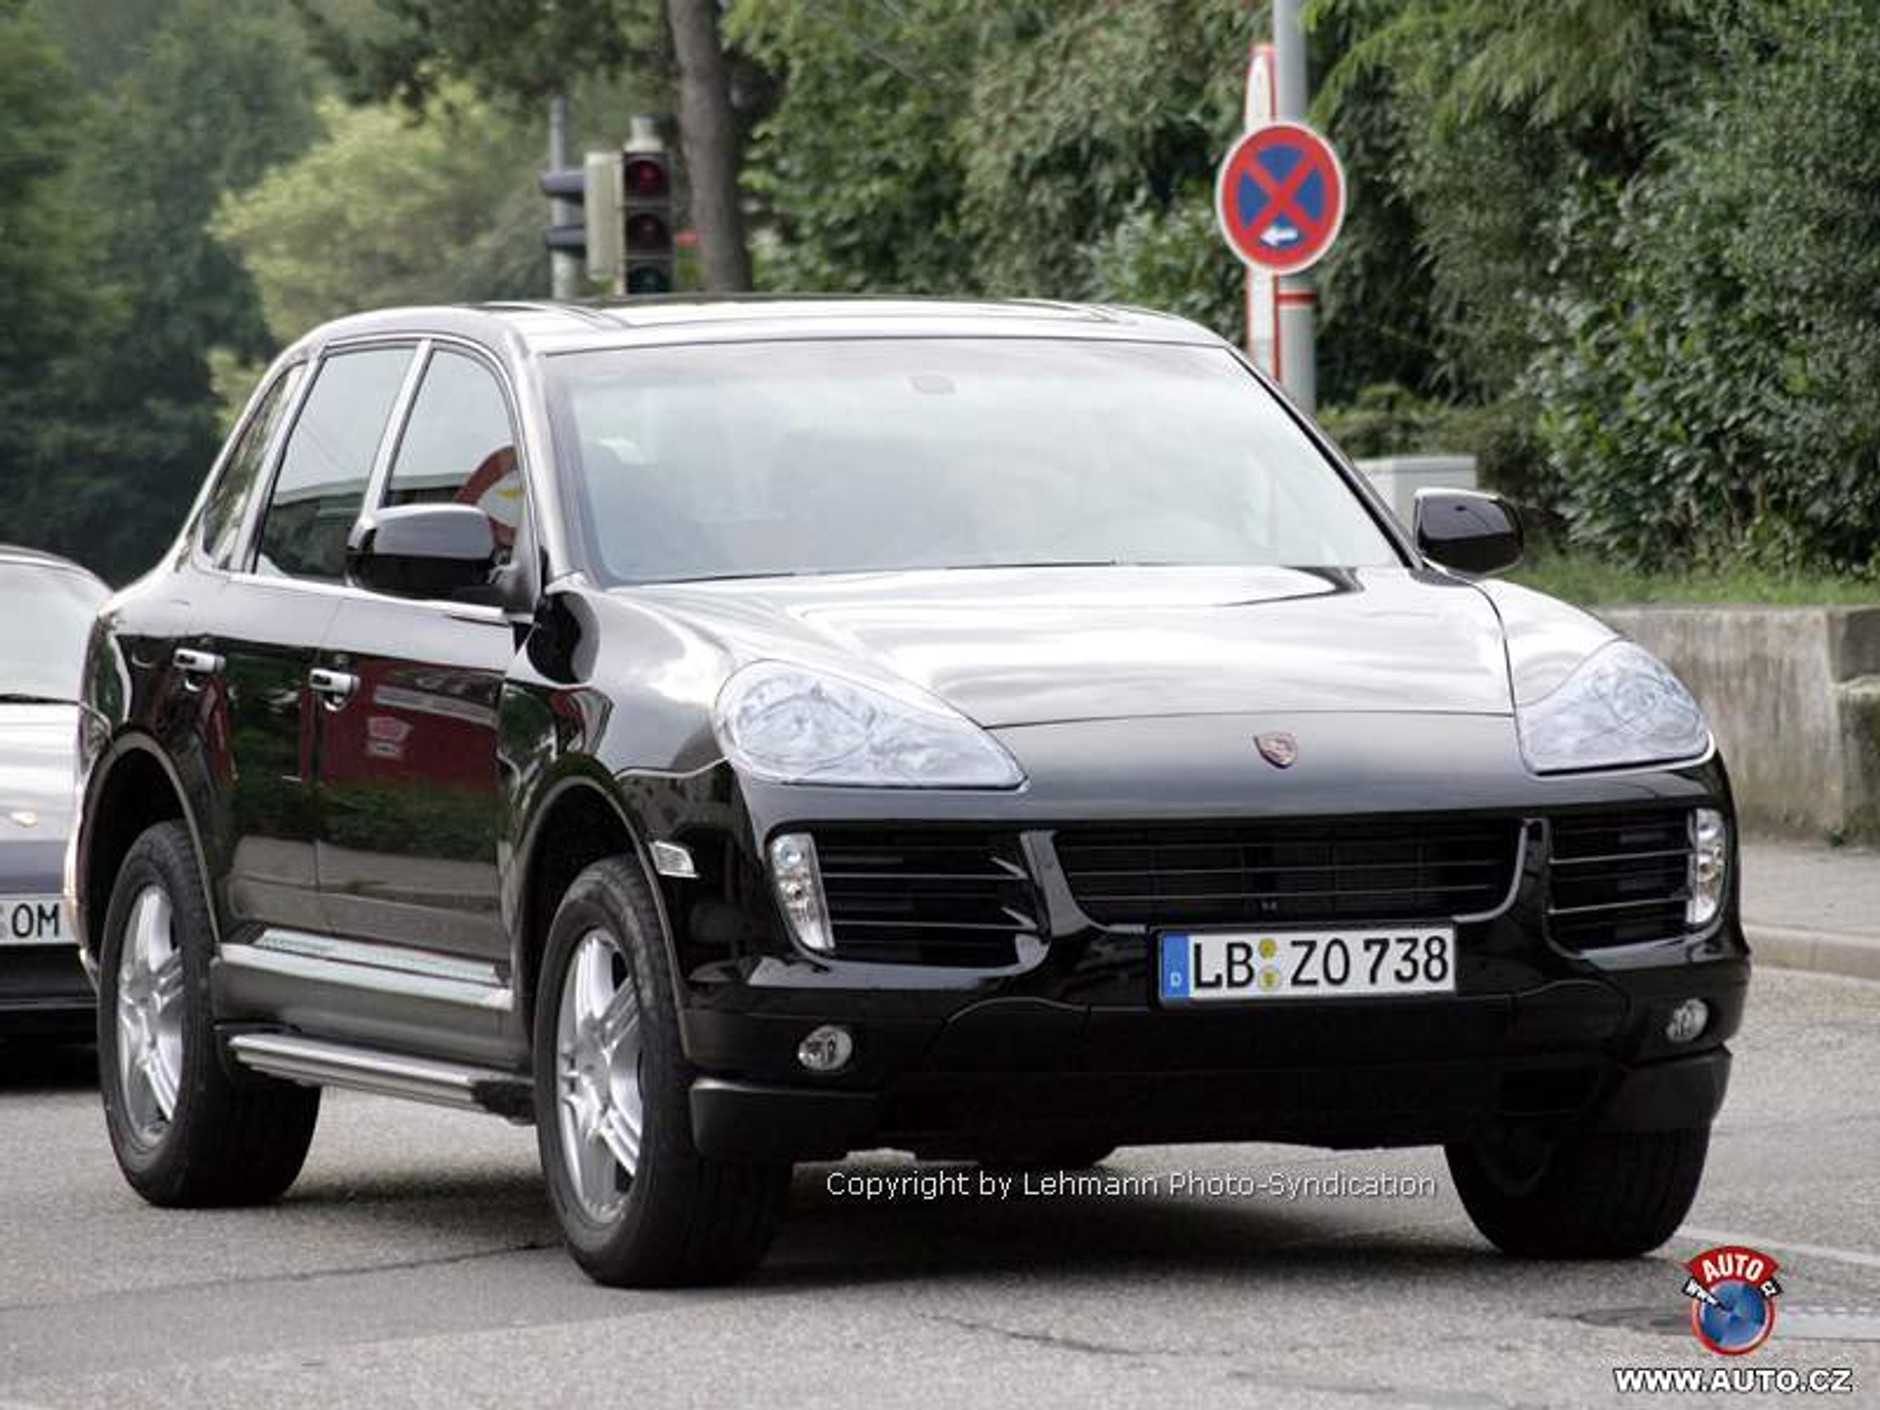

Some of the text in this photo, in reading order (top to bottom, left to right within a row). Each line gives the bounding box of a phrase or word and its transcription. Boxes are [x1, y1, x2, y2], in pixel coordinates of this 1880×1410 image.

[11, 902, 60, 938] OM
[1193, 941, 1254, 989] LB
[1290, 937, 1350, 987] ZO
[1363, 935, 1449, 984] 738
